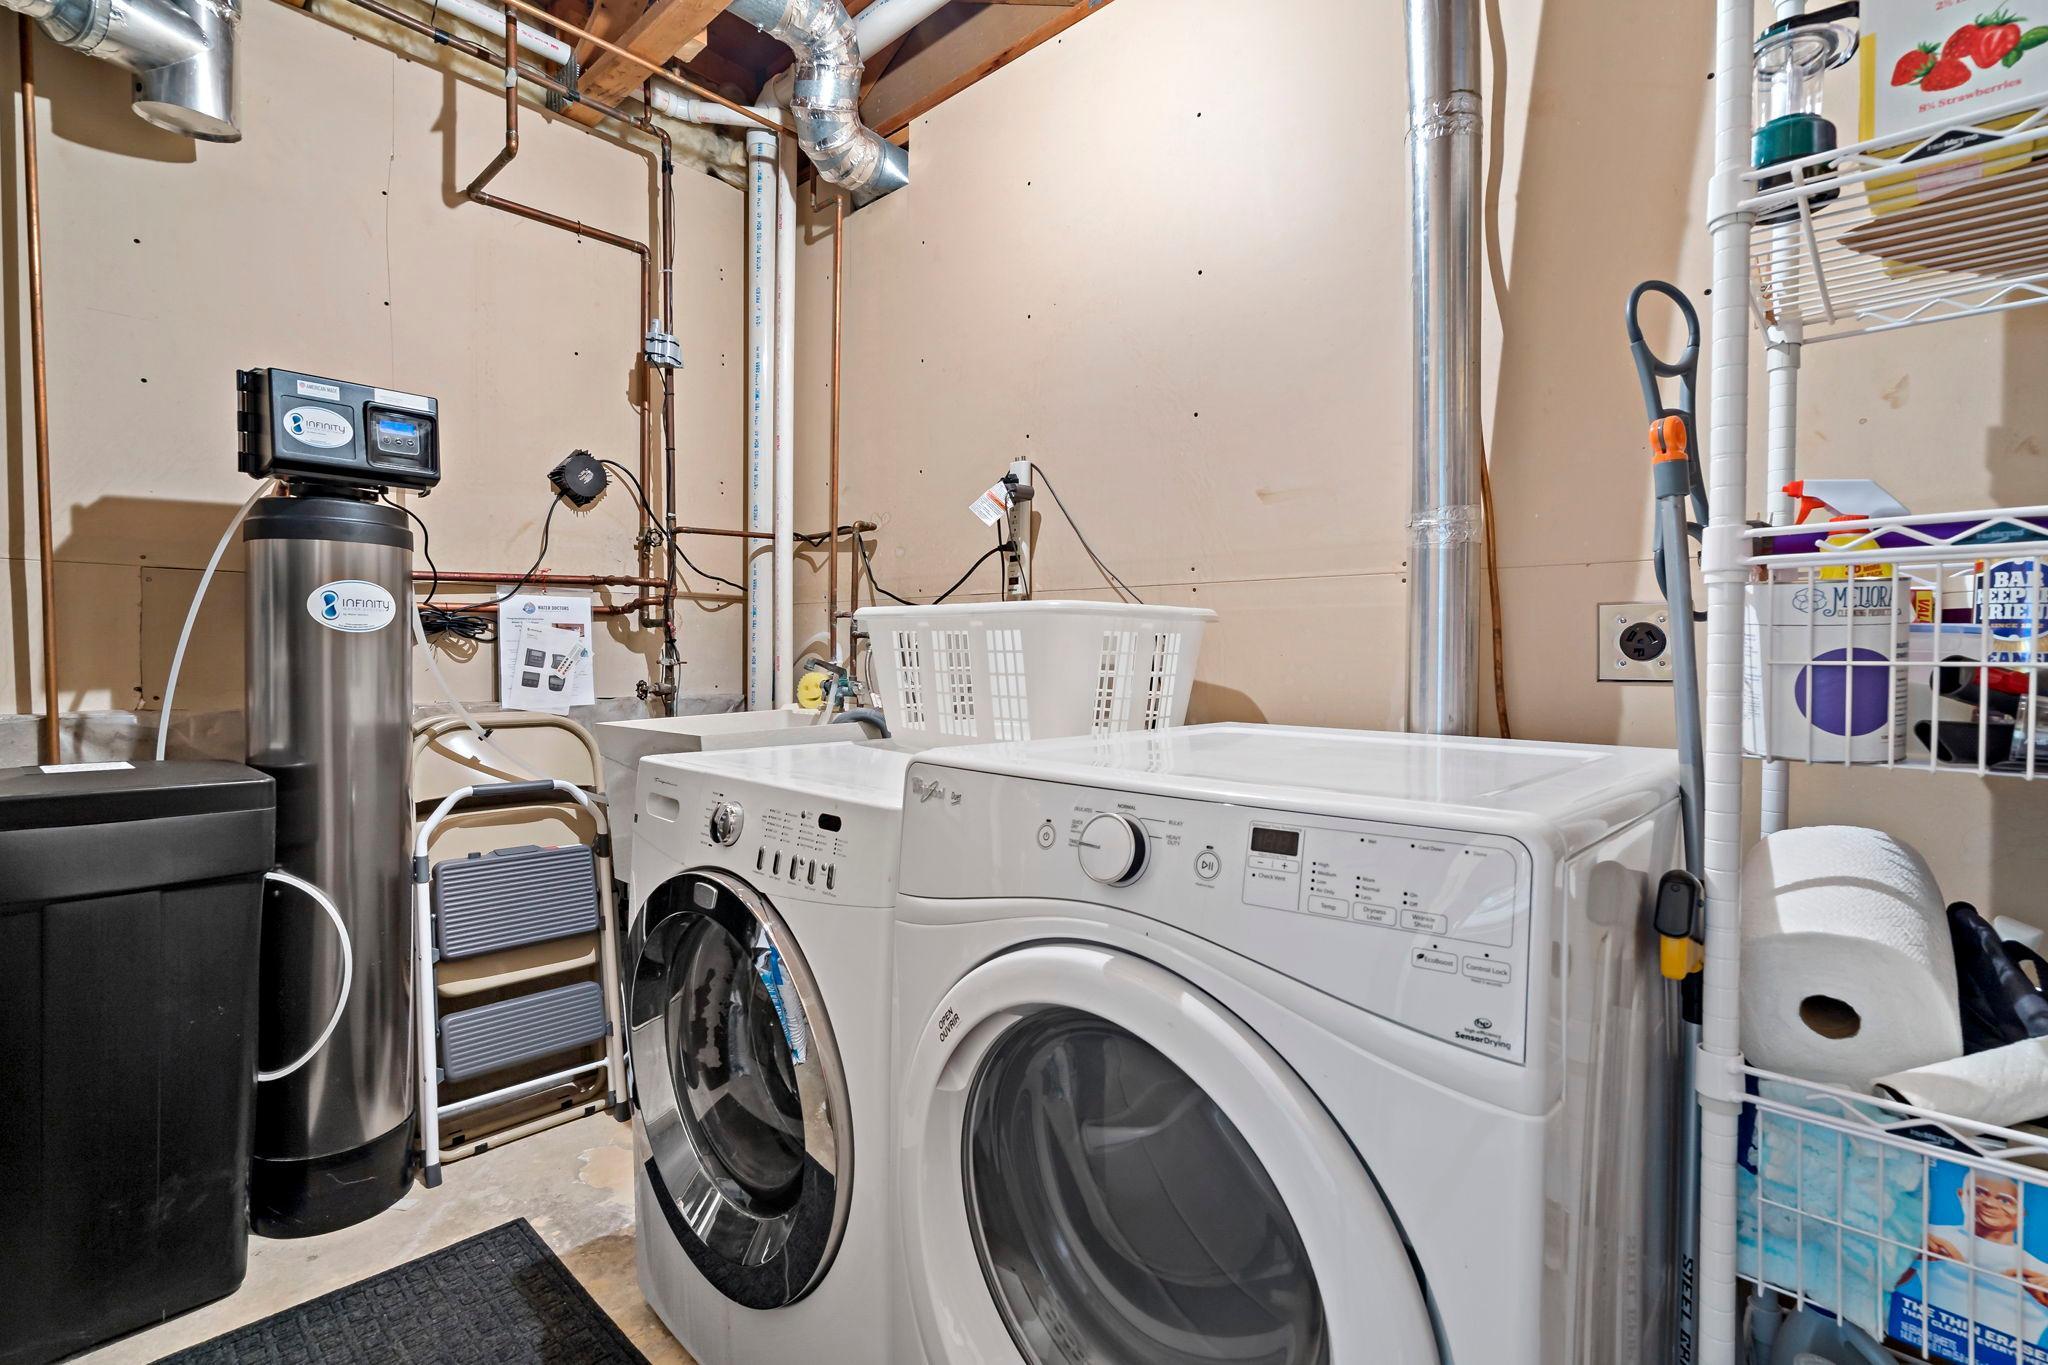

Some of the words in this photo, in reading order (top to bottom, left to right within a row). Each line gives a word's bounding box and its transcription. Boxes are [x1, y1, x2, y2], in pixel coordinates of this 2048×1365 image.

[1938, 78, 2022, 109] Strawberries
[306, 384, 326, 393] AMERICAN
[306, 420, 346, 434] INFINITY
[1994, 571, 2044, 588] BAR
[342, 598, 390, 612] INFINITY
[1321, 902, 1336, 911] Temp
[1363, 906, 1386, 915] Dryness
[1412, 914, 1435, 922] Wrinkle
[1414, 921, 1433, 930] Shield
[1424, 956, 1454, 967] EcoBoost
[1466, 963, 1491, 973] Control
[1492, 966, 1508, 976] Lock
[939, 1006, 953, 1029] OPEN
[940, 1013, 960, 1042] OUVRIR
[1455, 1031, 1512, 1050] SensorDrying
[1681, 1254, 1694, 1321] STEEL
[1902, 1308, 1925, 1322] THA
[1931, 1320, 1970, 1340] CLEAN
[1902, 1297, 1934, 1318] THE
[1985, 1329, 2048, 1361] ERASE
[1680, 1328, 1692, 1365] GR
